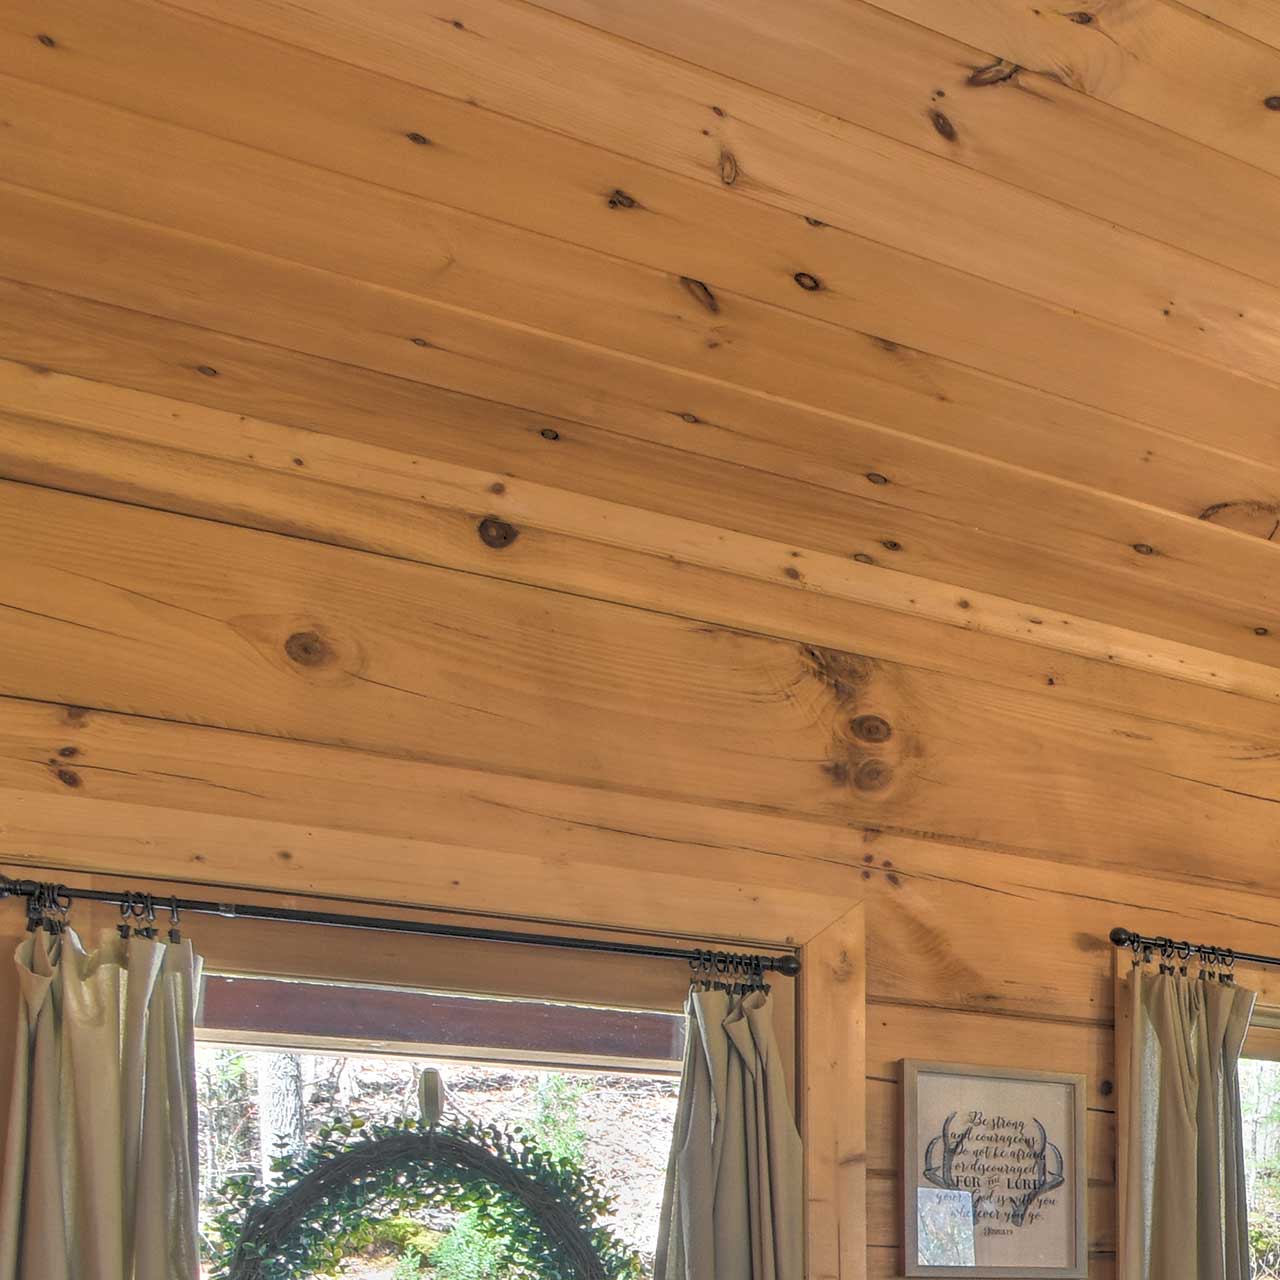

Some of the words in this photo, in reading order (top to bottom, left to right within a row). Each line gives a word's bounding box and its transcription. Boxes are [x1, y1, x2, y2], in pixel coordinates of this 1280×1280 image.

[969, 1111, 988, 1126] Be
[992, 1116, 1025, 1135] strong
[973, 1146, 988, 1159] not
[993, 1147, 1006, 1159] be
[955, 1162, 966, 1172] or
[970, 1158, 1037, 1178] discouraged
[955, 1175, 981, 1188] FOR
[1037, 1197, 1056, 1208] you
